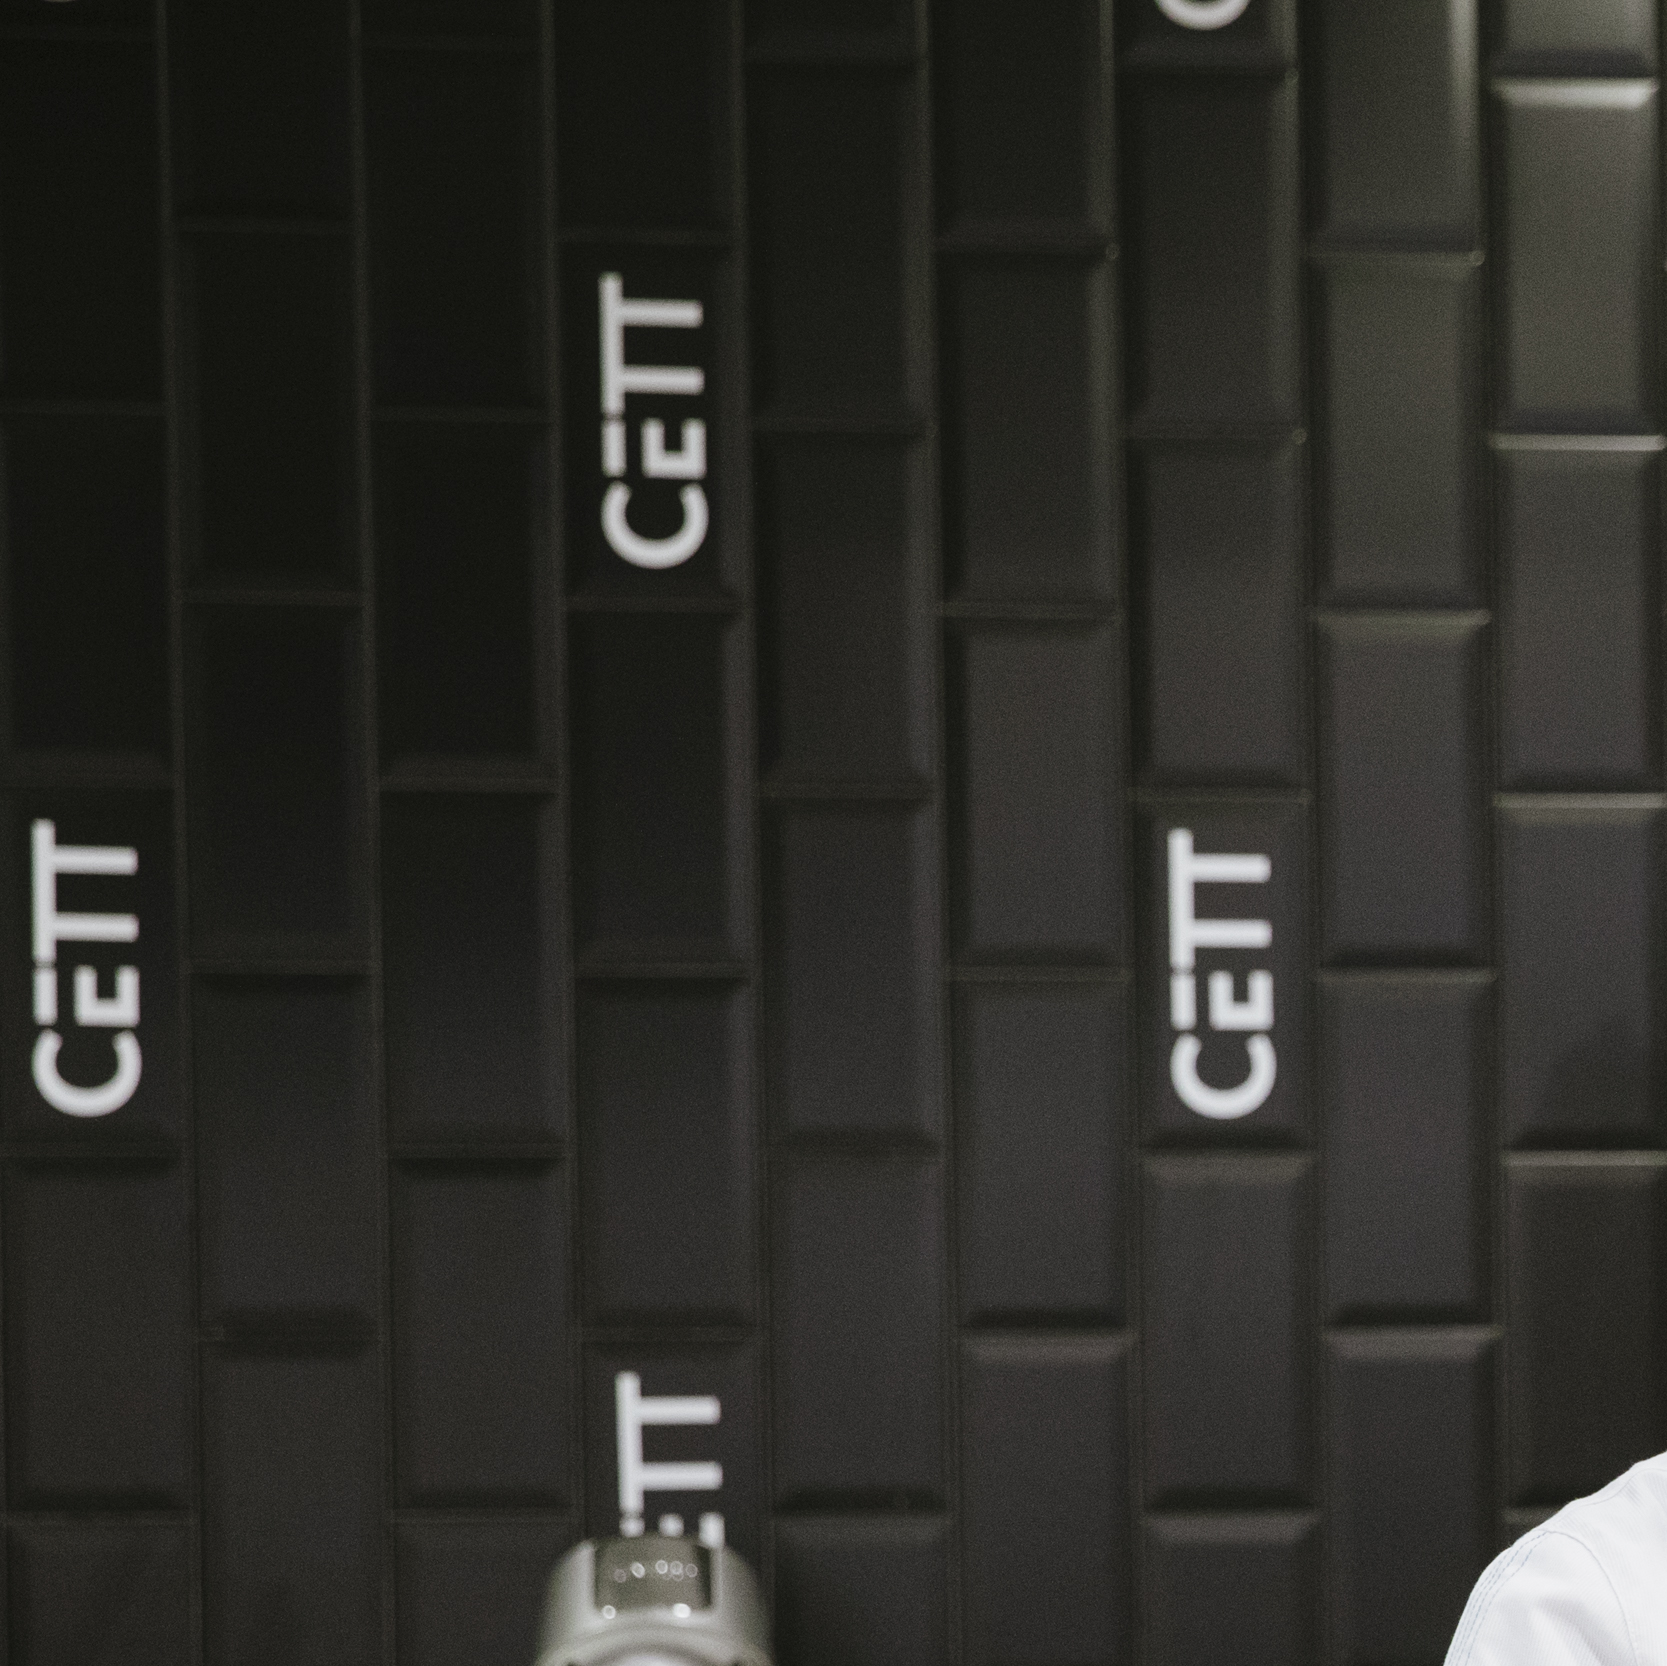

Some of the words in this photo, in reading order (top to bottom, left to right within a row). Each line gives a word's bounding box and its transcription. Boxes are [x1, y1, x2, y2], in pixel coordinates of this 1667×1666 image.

[599, 273, 709, 569] CETT
[31, 818, 143, 1118] CETT
[1167, 828, 1278, 1120] CETT
